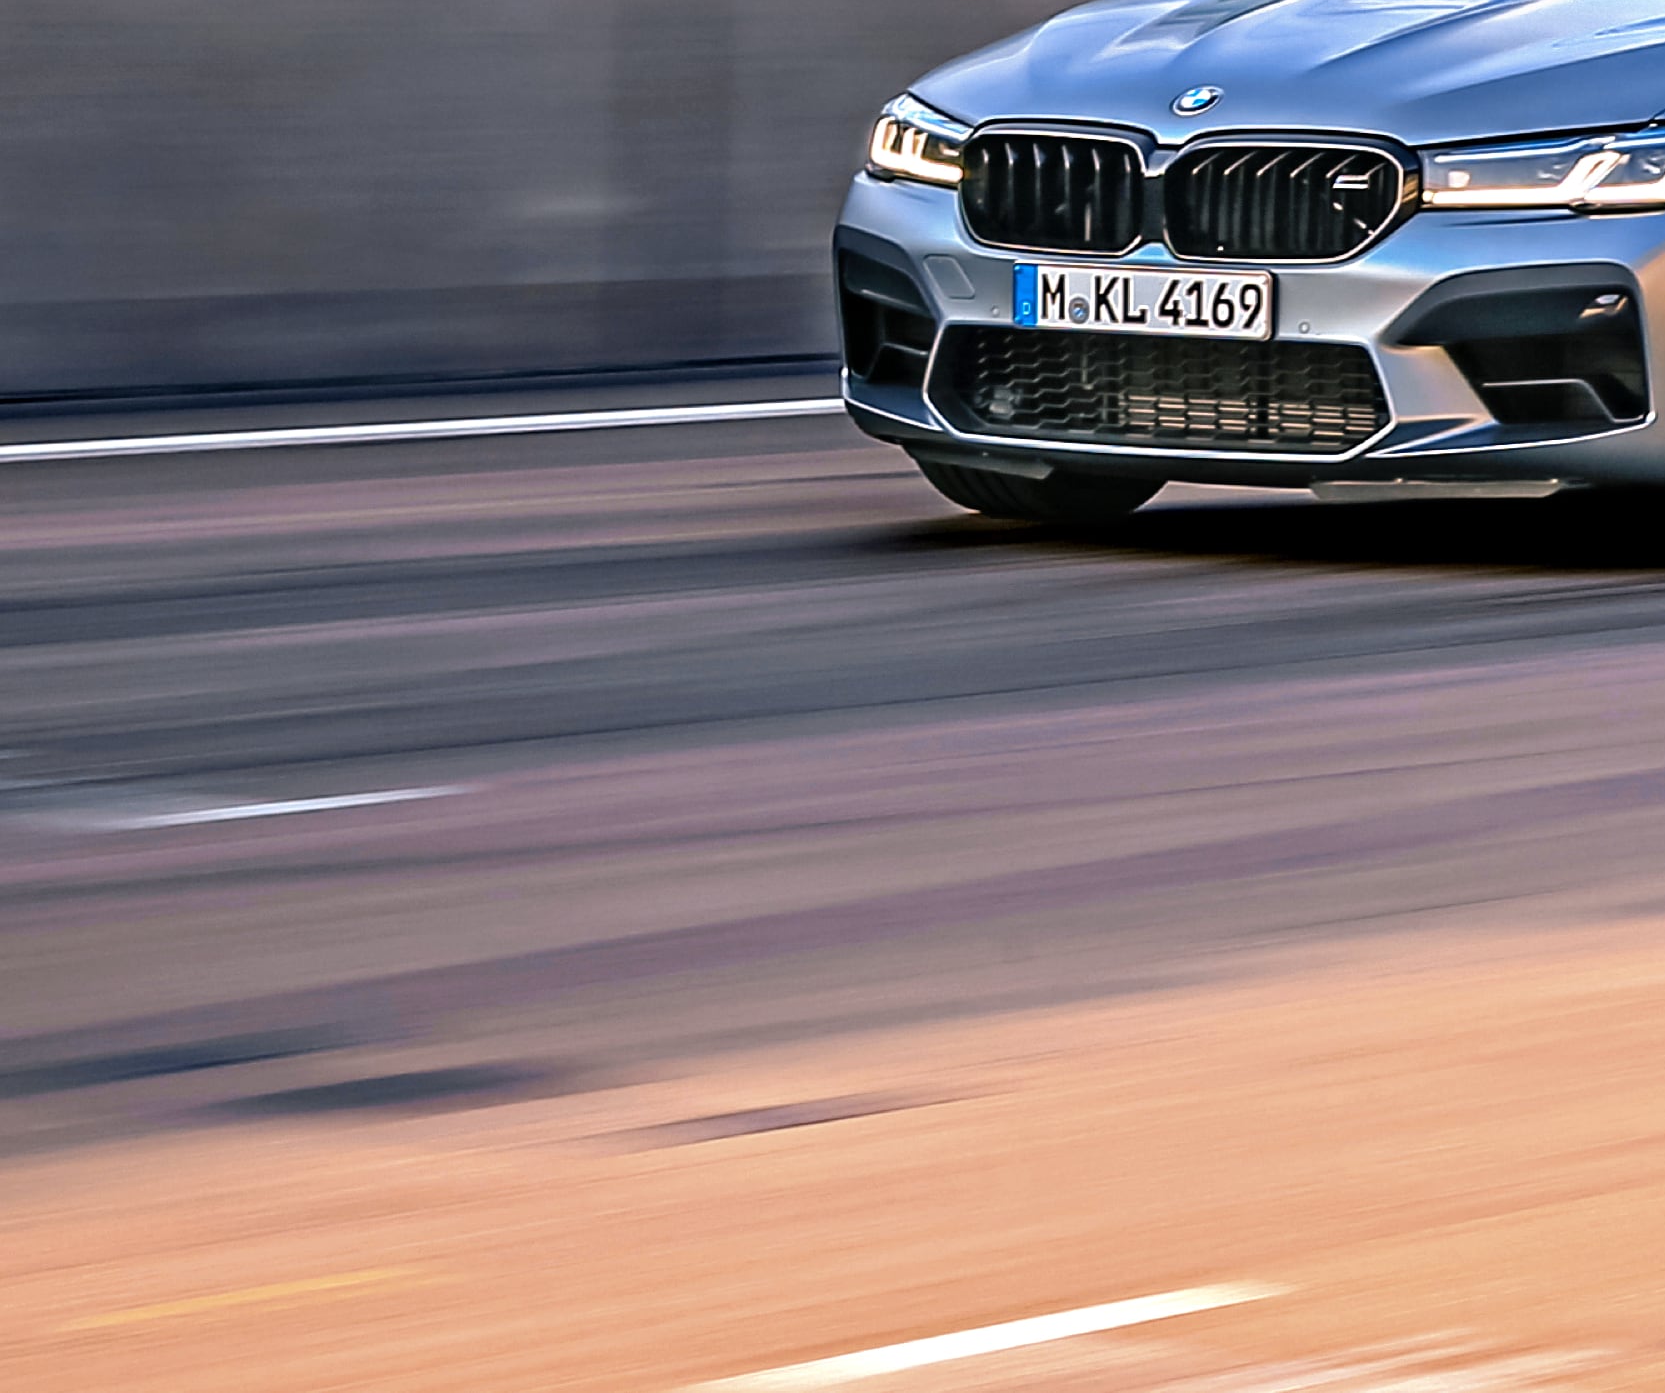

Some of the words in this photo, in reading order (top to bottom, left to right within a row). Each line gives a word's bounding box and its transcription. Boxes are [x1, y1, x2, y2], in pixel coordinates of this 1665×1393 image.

[1041, 273, 1066, 320] M
[1094, 275, 1148, 324] KL
[1158, 279, 1262, 329] 4169
